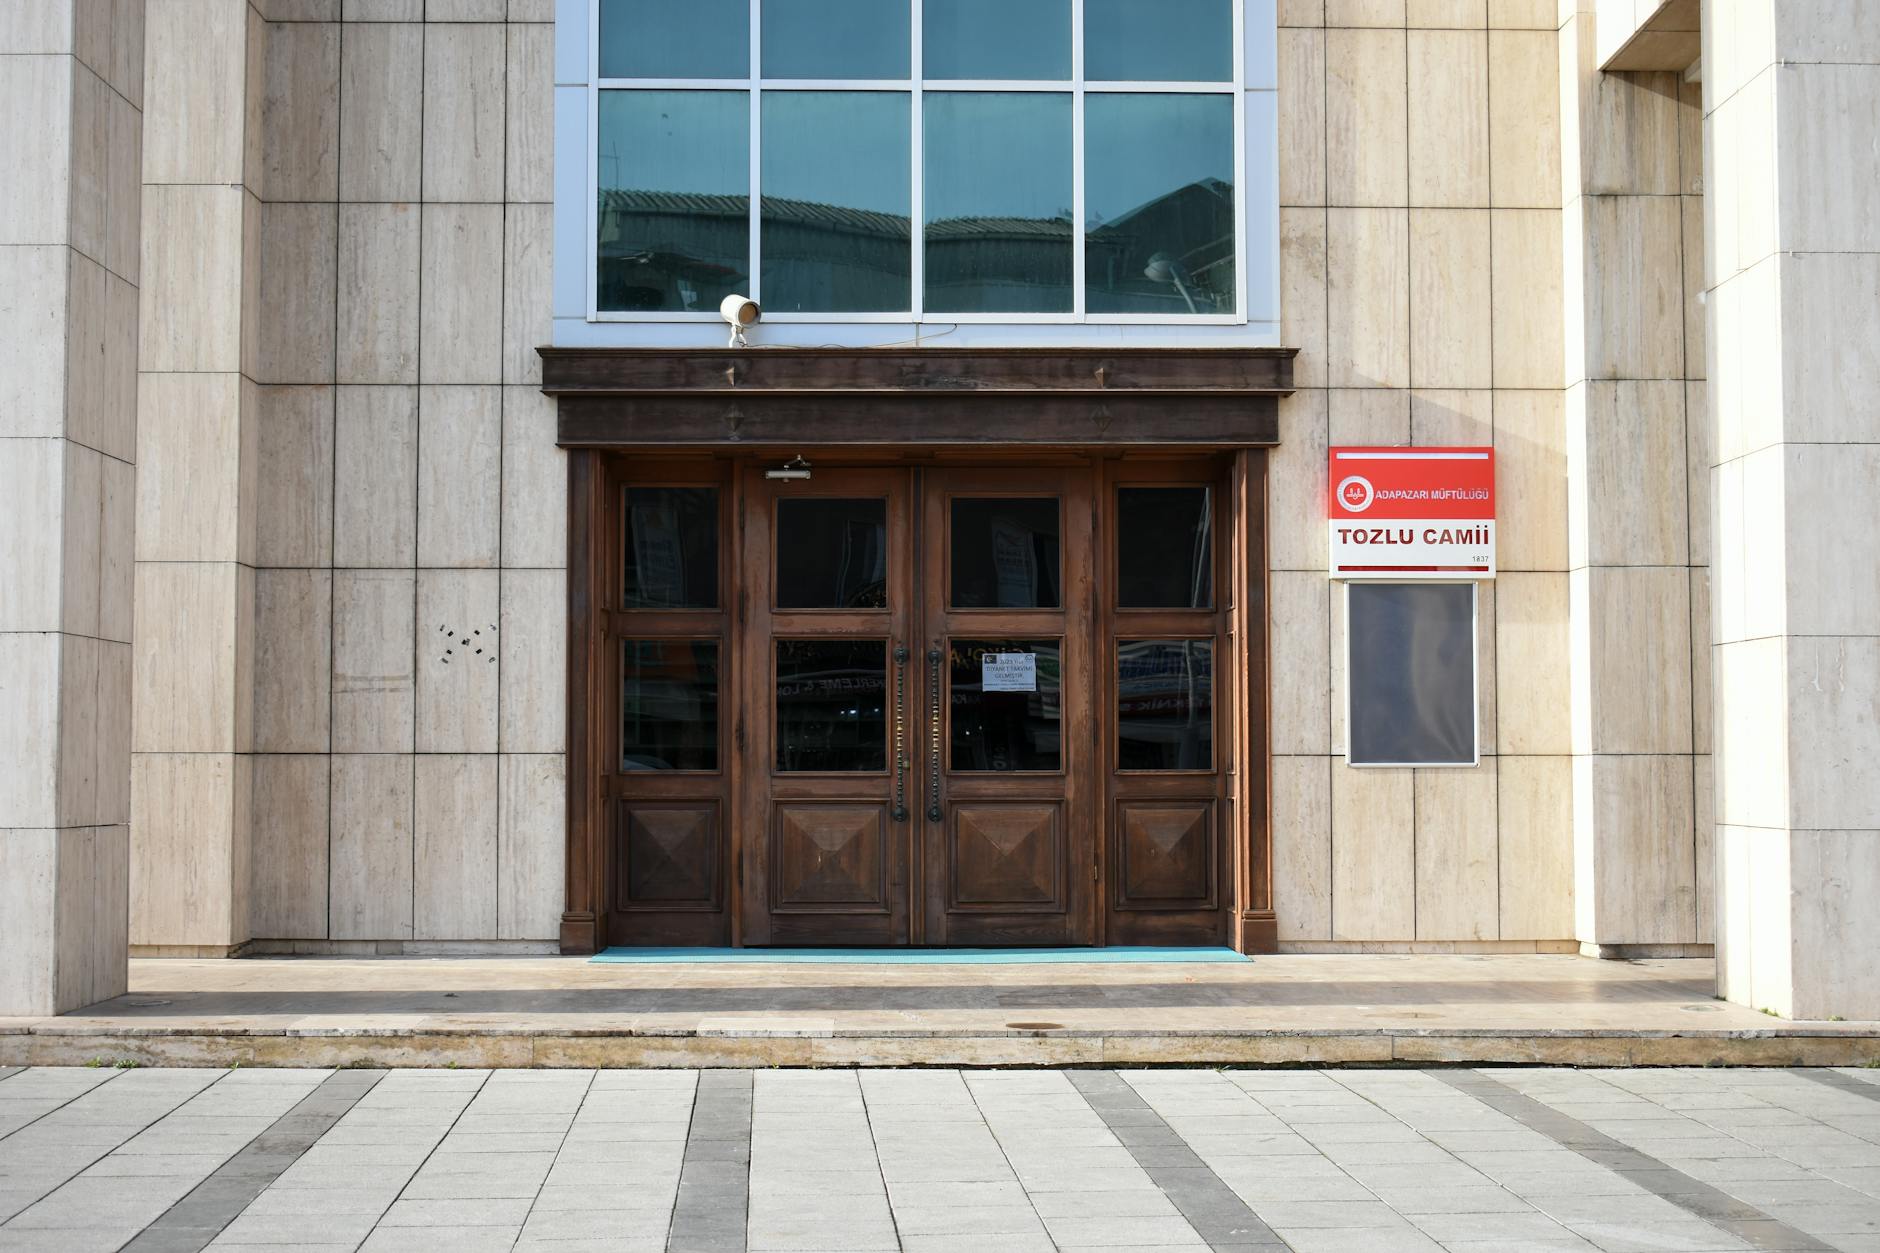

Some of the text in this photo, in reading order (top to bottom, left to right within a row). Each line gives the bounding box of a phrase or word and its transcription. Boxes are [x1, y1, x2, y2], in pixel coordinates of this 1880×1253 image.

[1376, 488, 1489, 499] ADAPAZARI MÜFTÜLÜĞÜ
[1338, 525, 1489, 545] TOZLU CAMİİ
